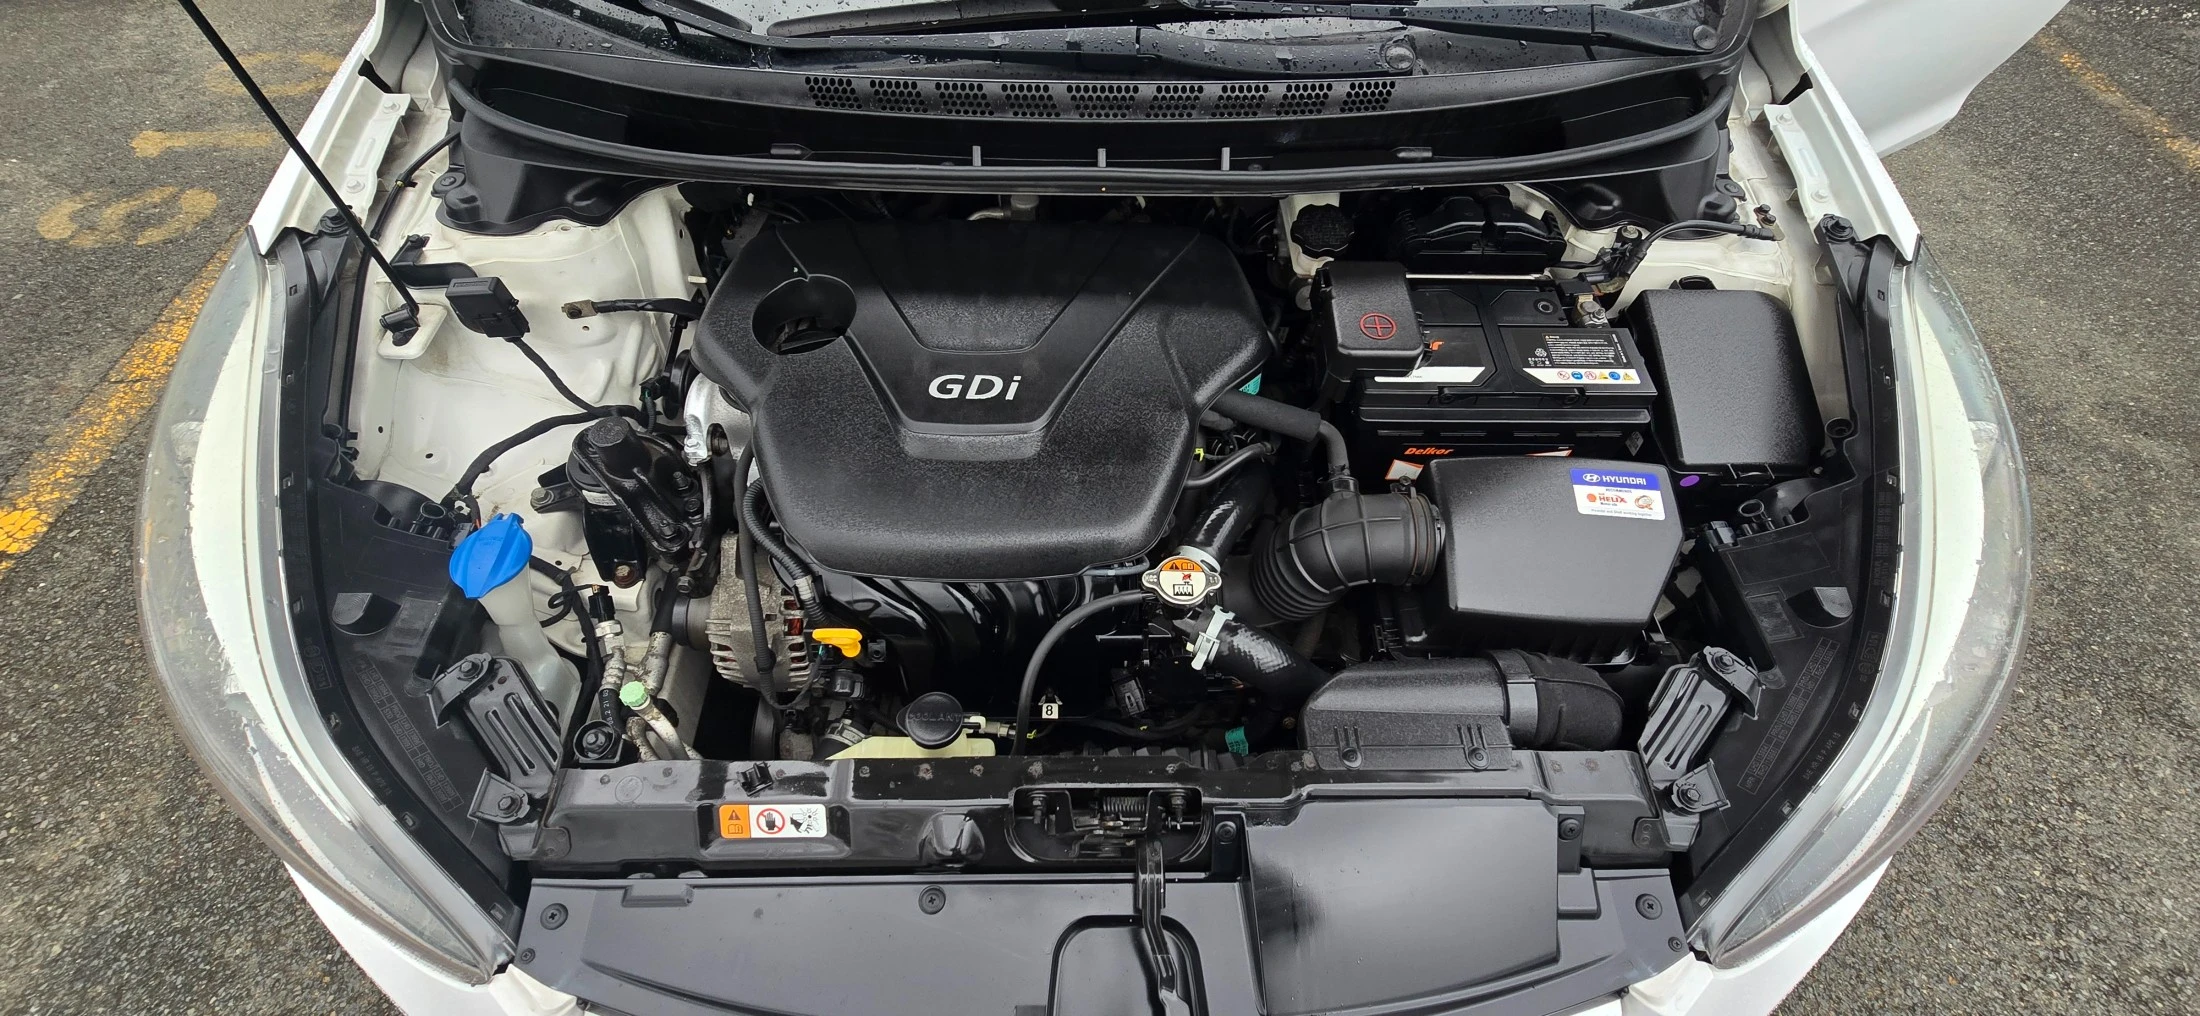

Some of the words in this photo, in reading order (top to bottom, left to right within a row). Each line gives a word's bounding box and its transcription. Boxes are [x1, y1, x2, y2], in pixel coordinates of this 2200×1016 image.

[928, 374, 1022, 400] GDi
[1404, 447, 1454, 455] Delkor
[1602, 475, 1647, 485] HYUNDAI
[1599, 494, 1627, 503] HELIX
[1045, 705, 1053, 716] 8
[908, 712, 962, 722] COOLANT
